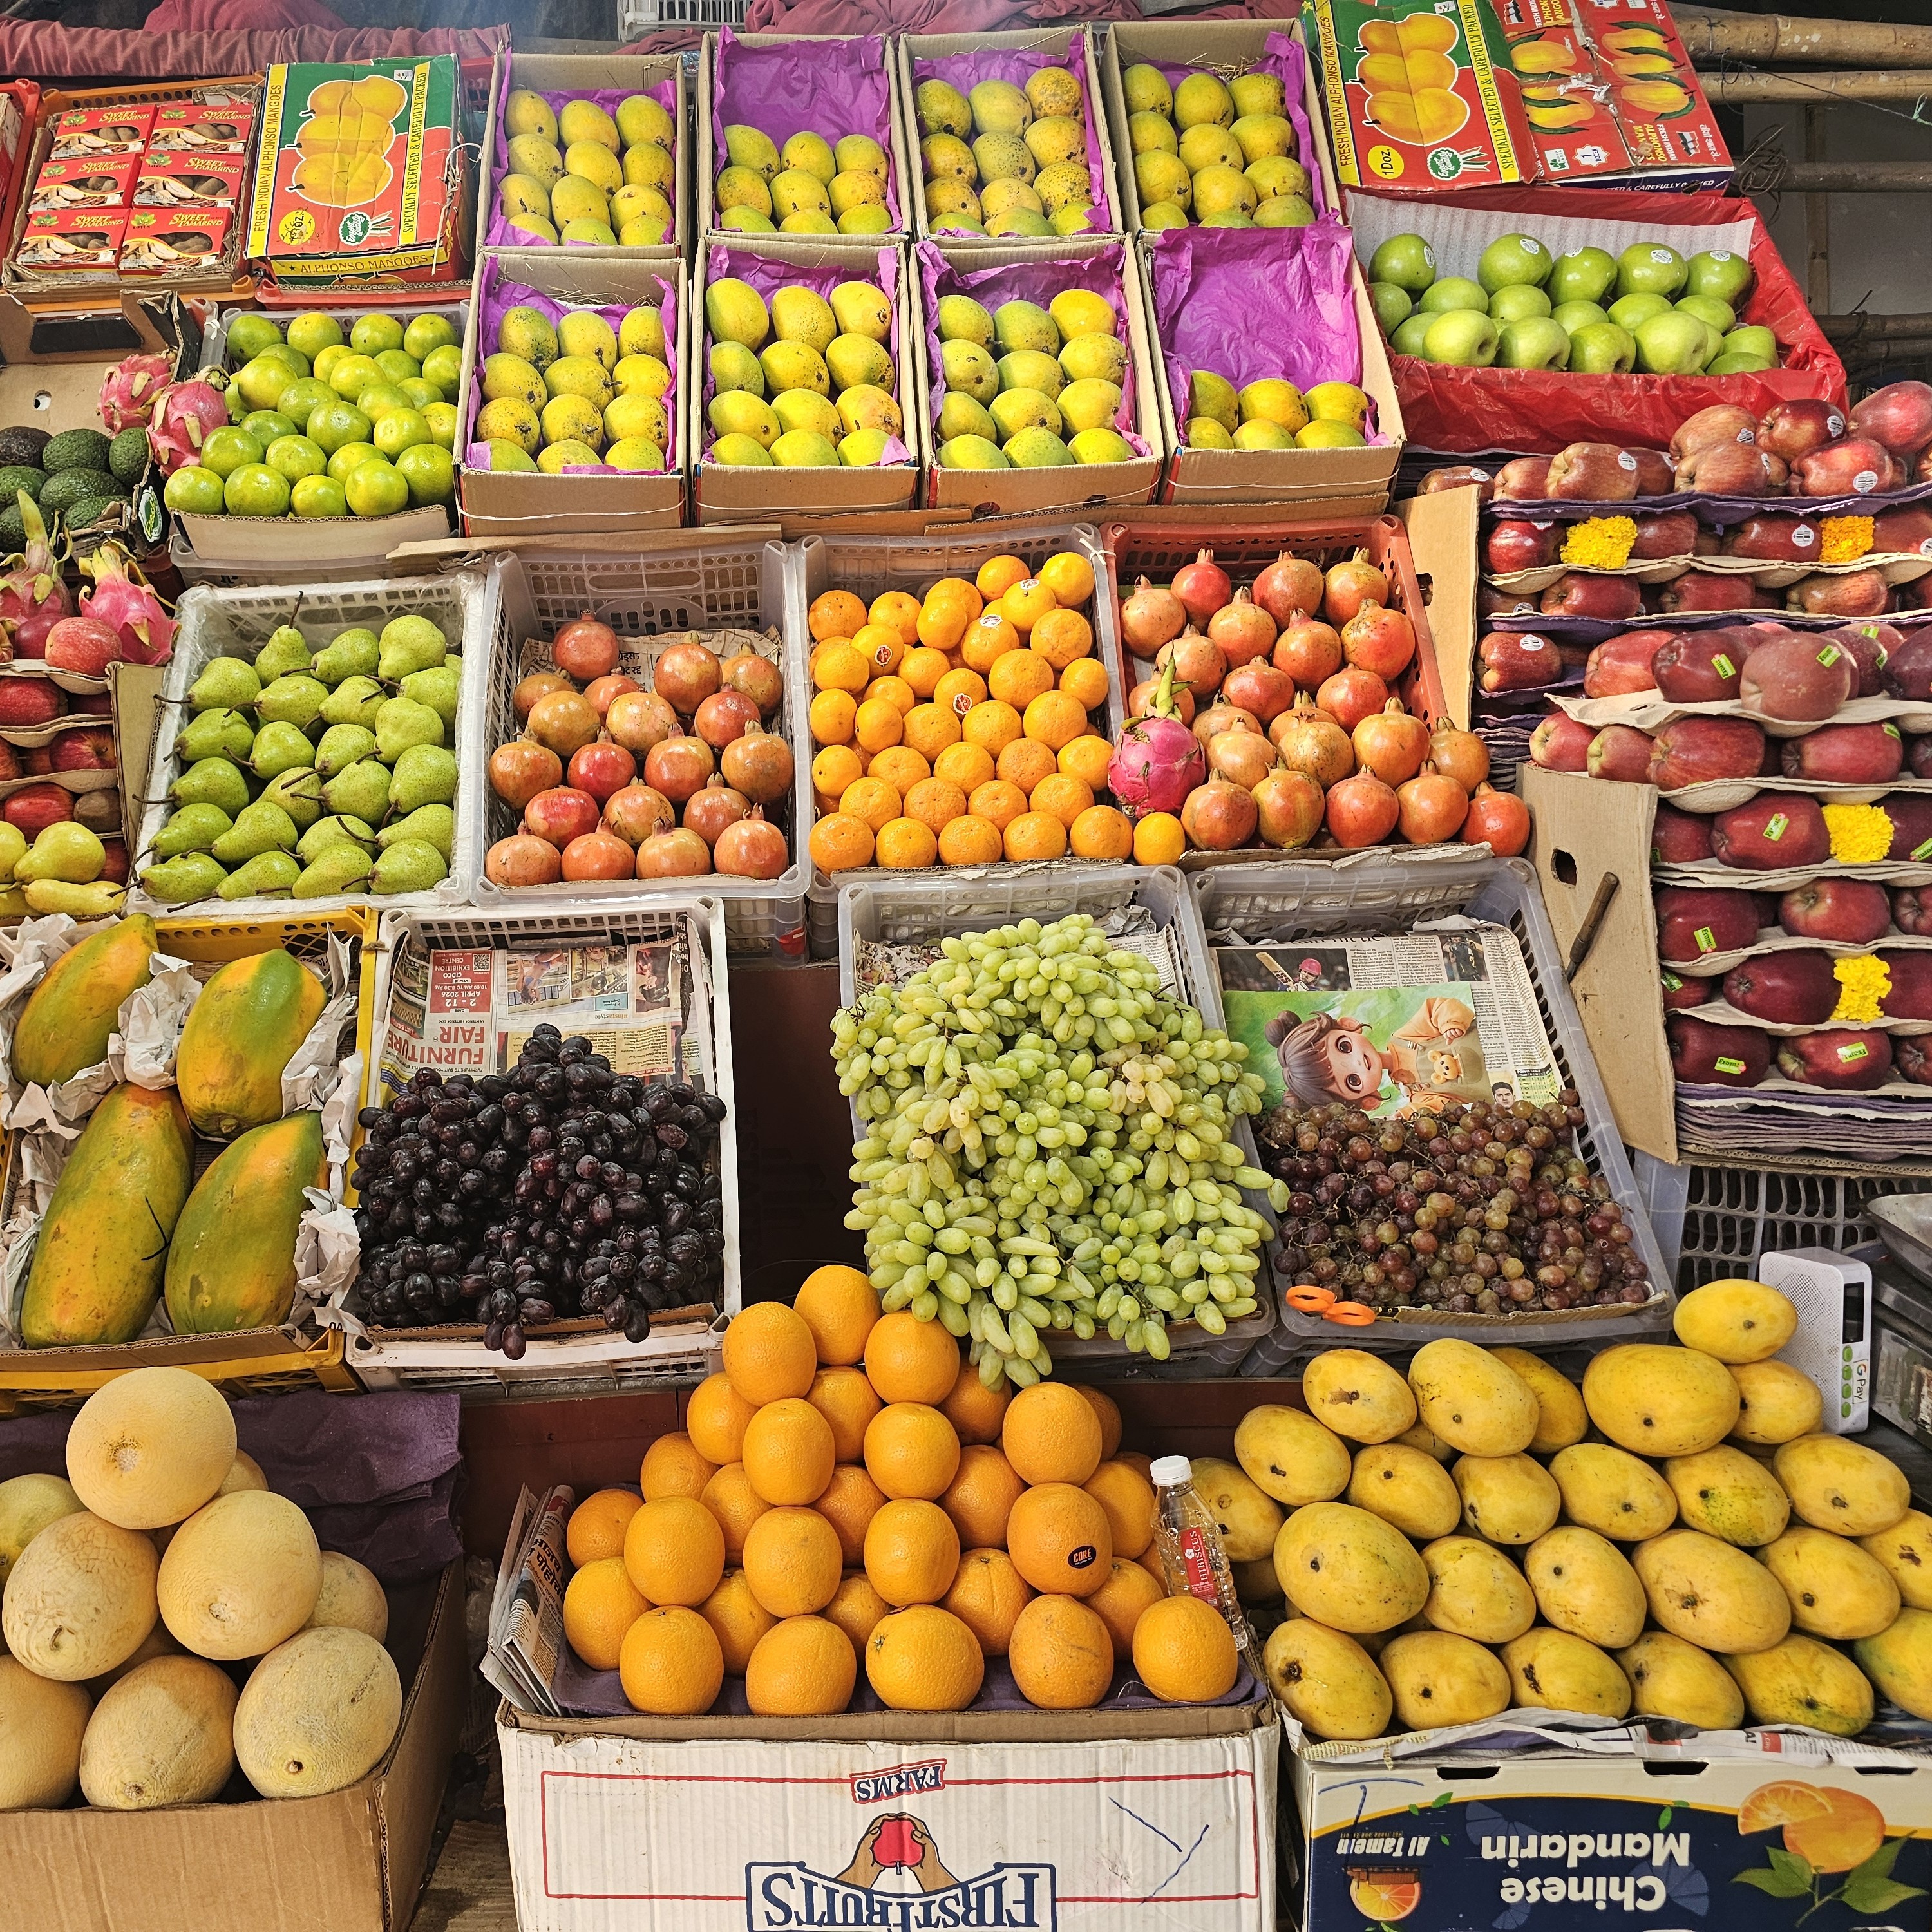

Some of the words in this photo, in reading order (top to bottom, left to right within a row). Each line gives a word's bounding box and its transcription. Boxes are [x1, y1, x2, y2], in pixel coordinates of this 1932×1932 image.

[1461, 4, 1479, 33] PACKED
[1469, 34, 1490, 77] CAREFULLY
[415, 71, 426, 99] PACKED
[1325, 59, 1343, 104] ALPHONSO
[99, 111, 137, 122] SWEET
[106, 114, 150, 123] TAMARIND
[198, 110, 238, 119] SWEET
[268, 84, 282, 126] MANGOES
[1482, 87, 1503, 126] SELECTED
[411, 100, 423, 141] CAREFULLY
[1332, 106, 1348, 135] INDIAN
[261, 126, 277, 166] ALPHONSO
[410, 142, 418, 151] &
[1336, 137, 1352, 167] FRESH
[1493, 128, 1515, 169] SPECIALLY
[1592, 148, 1602, 162] DOZEN
[1643, 123, 1667, 162] ALPHONSO
[1656, 124, 1670, 142] FRESH
[1663, 141, 1678, 161] INDIAN
[77, 161, 118, 173] SWEET
[87, 164, 129, 173] TAMARIND
[184, 157, 226, 167] SWEET
[194, 164, 240, 173] TAMARIND
[406, 151, 420, 191] SELECTED
[259, 167, 270, 203] INDIAN
[1634, 182, 1681, 191] CAREFULLY
[70, 214, 112, 227] SWEET
[79, 220, 124, 228] TAMARIND
[169, 213, 211, 225] SWEET
[254, 204, 265, 232] FRESH
[402, 191, 416, 232] SPECIALLY
[300, 261, 365, 274] ALPHONSO
[368, 254, 428, 269] MANGOES
[1701, 928, 1714, 947] From:
[445, 998, 458, 1007] 12
[469, 998, 476, 1007] 2
[388, 1029, 484, 1065] FURNITURE
[439, 1026, 485, 1044] FAIR
[1719, 1058, 1739, 1067] From:
[1853, 1378, 1866, 1401] Pay
[1073, 1548, 1092, 1564] CORE
[1189, 1531, 1209, 1584] HIBISCUS
[856, 1766, 943, 1802] FARMS
[1481, 1833, 1690, 1868] Mandarin
[1500, 1875, 1667, 1911] Chinese
